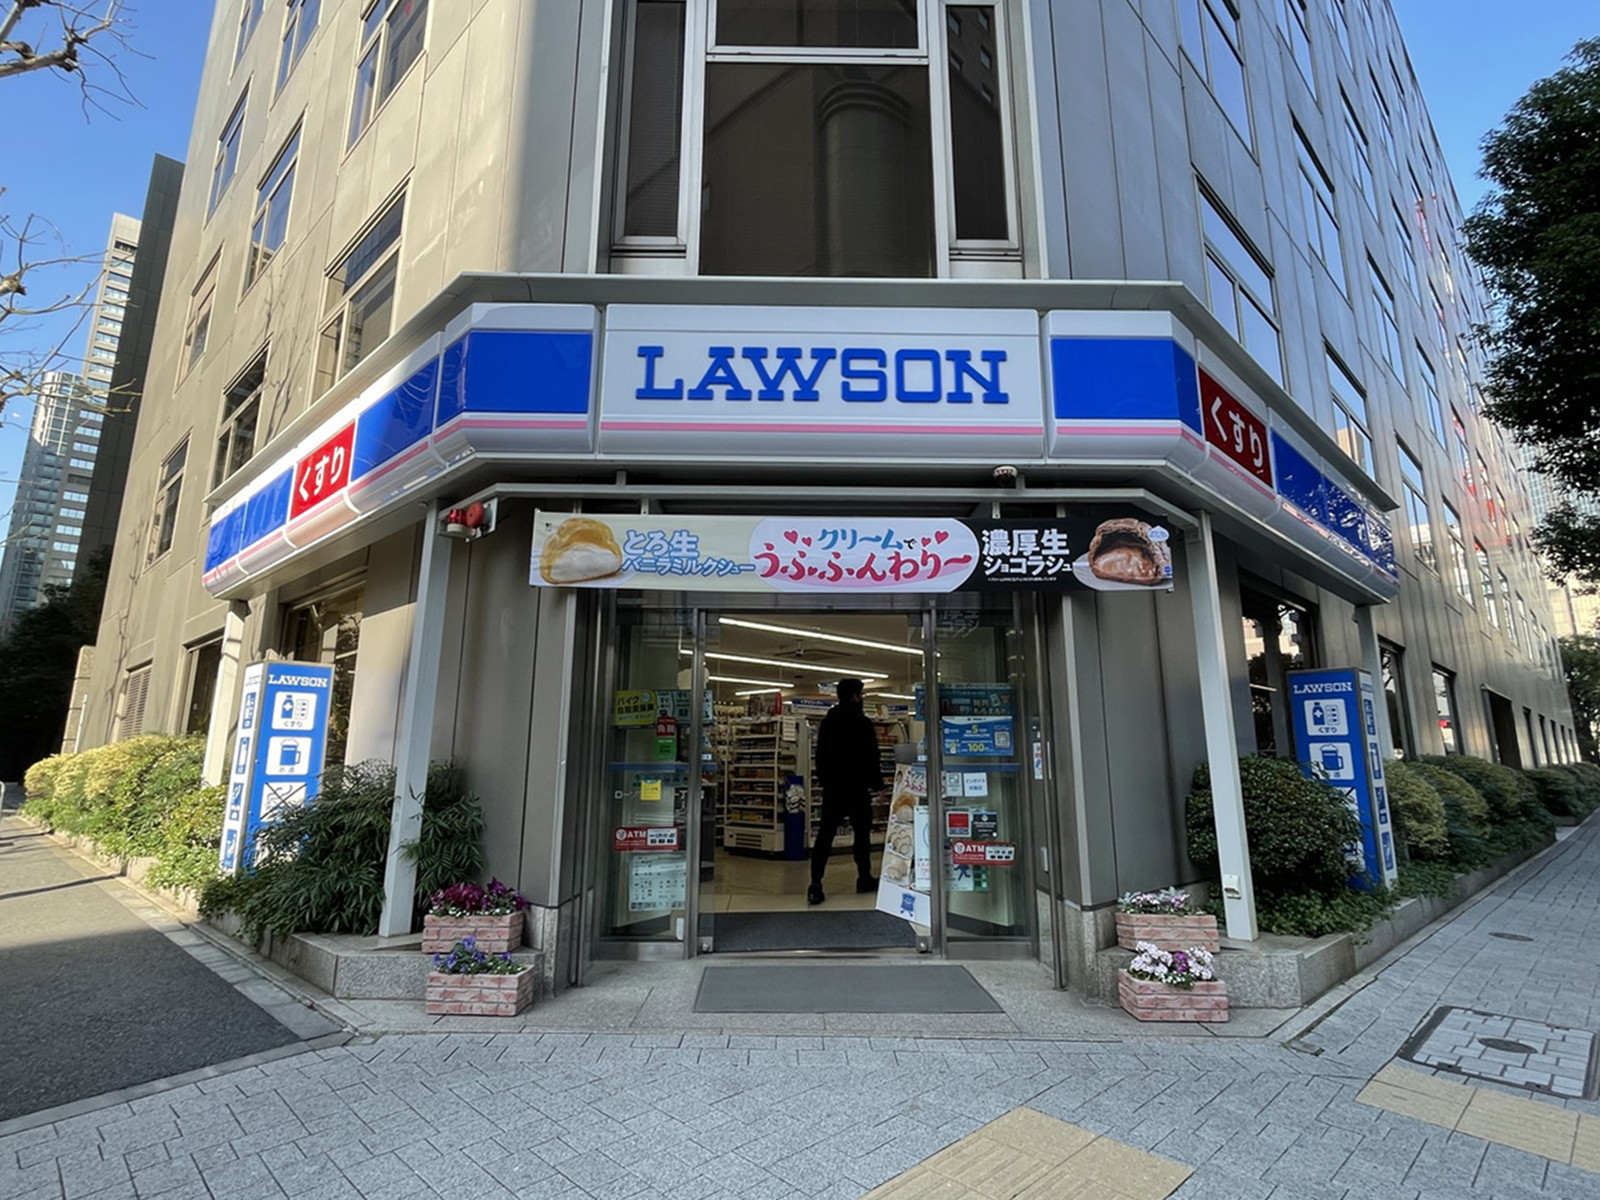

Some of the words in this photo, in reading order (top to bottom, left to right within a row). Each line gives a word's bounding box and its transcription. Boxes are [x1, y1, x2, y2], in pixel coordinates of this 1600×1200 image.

[636, 346, 1009, 404] LAWSON
[1211, 396, 1264, 468] くすり
[298, 446, 345, 501] くすり
[622, 529, 700, 557] とろ生
[981, 528, 1070, 556] 濃厚生
[621, 556, 756, 578] バニラミルクシュー
[268, 674, 328, 688] LAWSON
[1293, 682, 1352, 694] LAWSON
[617, 696, 639, 705] バイク
[283, 720, 303, 728] くすり
[1318, 726, 1338, 734] くすり
[627, 830, 647, 839] ATM
[965, 845, 985, 853] ATM
